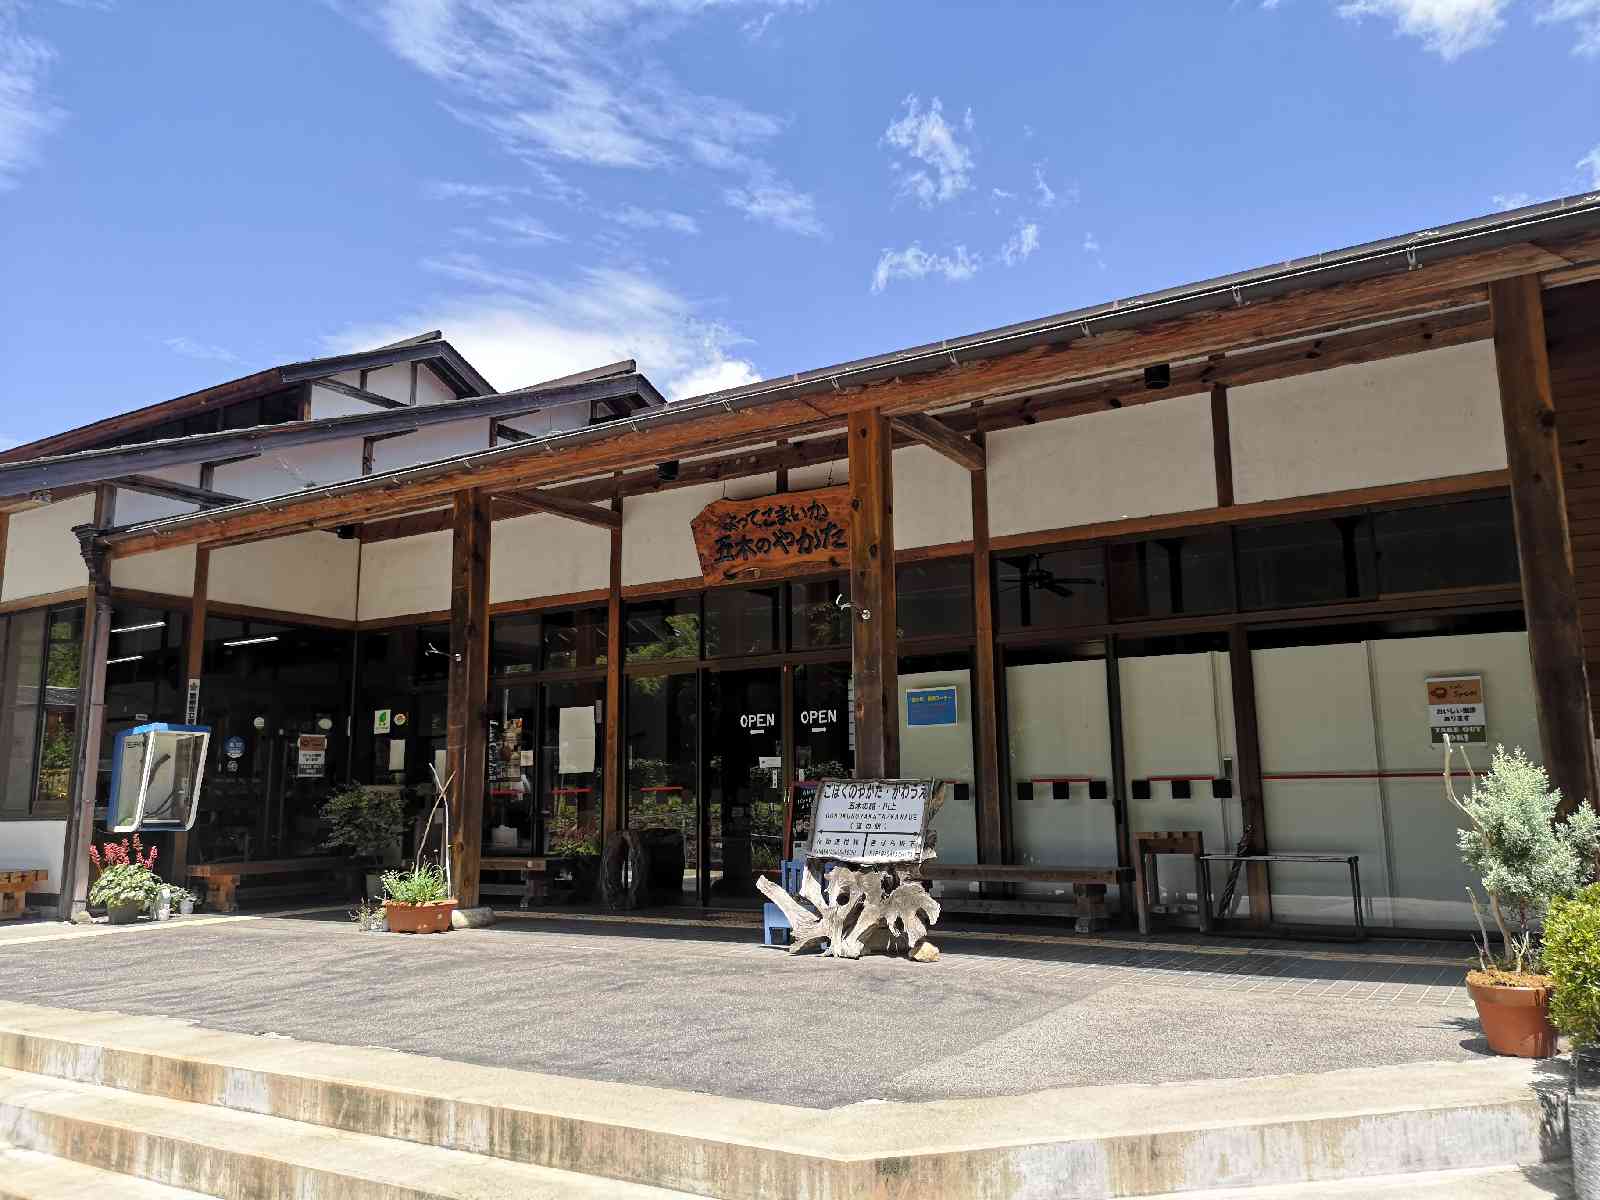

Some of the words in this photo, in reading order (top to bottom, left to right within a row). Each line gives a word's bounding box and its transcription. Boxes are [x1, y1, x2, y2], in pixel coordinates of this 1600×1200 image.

[714, 521, 848, 562] 五木のやかた
[740, 713, 775, 728] OPEN
[800, 709, 837, 724] OPEN
